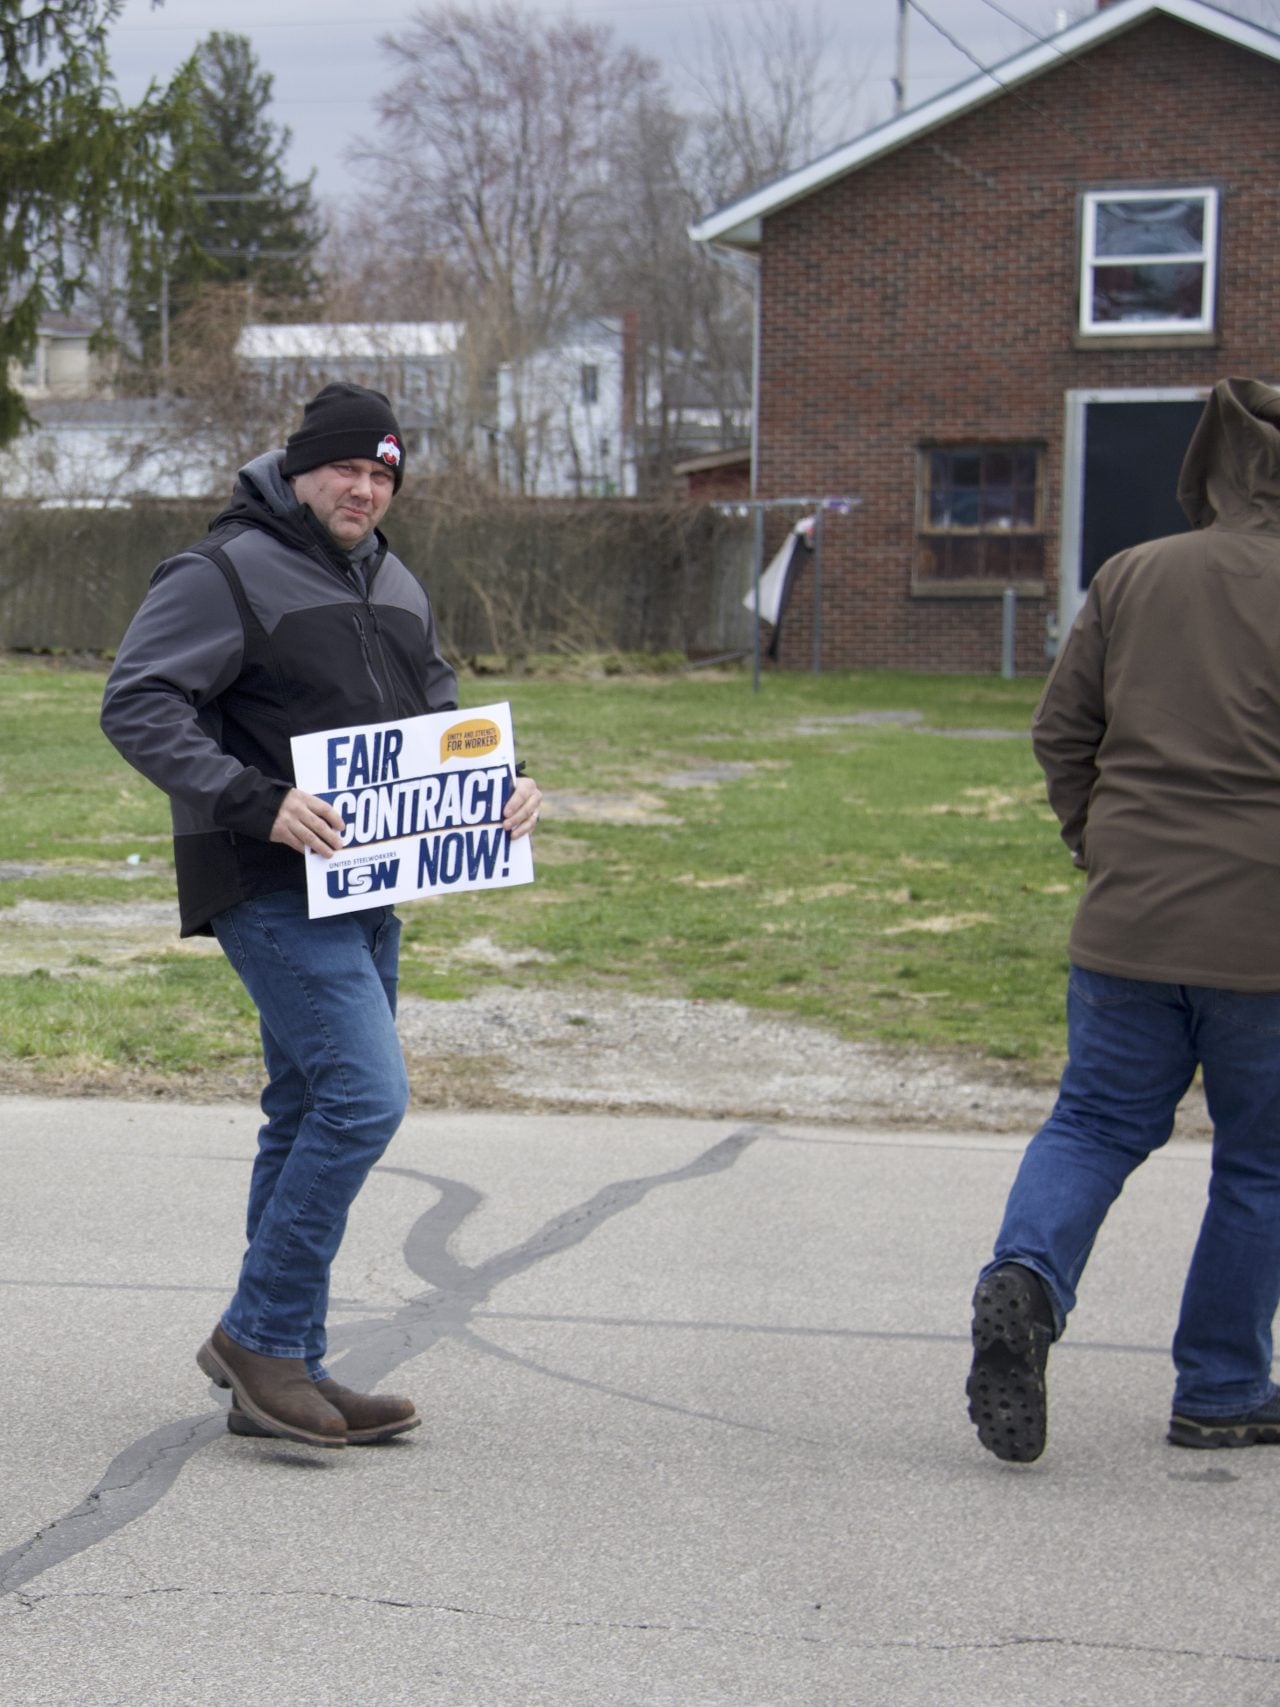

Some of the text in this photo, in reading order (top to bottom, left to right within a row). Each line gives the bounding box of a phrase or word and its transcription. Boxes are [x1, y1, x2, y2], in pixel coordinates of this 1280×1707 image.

[327, 729, 403, 789] FAIR
[447, 735, 498, 751] FOR WORKERS
[333, 767, 508, 847] CONTRACT
[327, 858, 400, 899] USW
[329, 851, 397, 869] UNITED STEELWORKERS
[417, 828, 512, 889] NOW!
